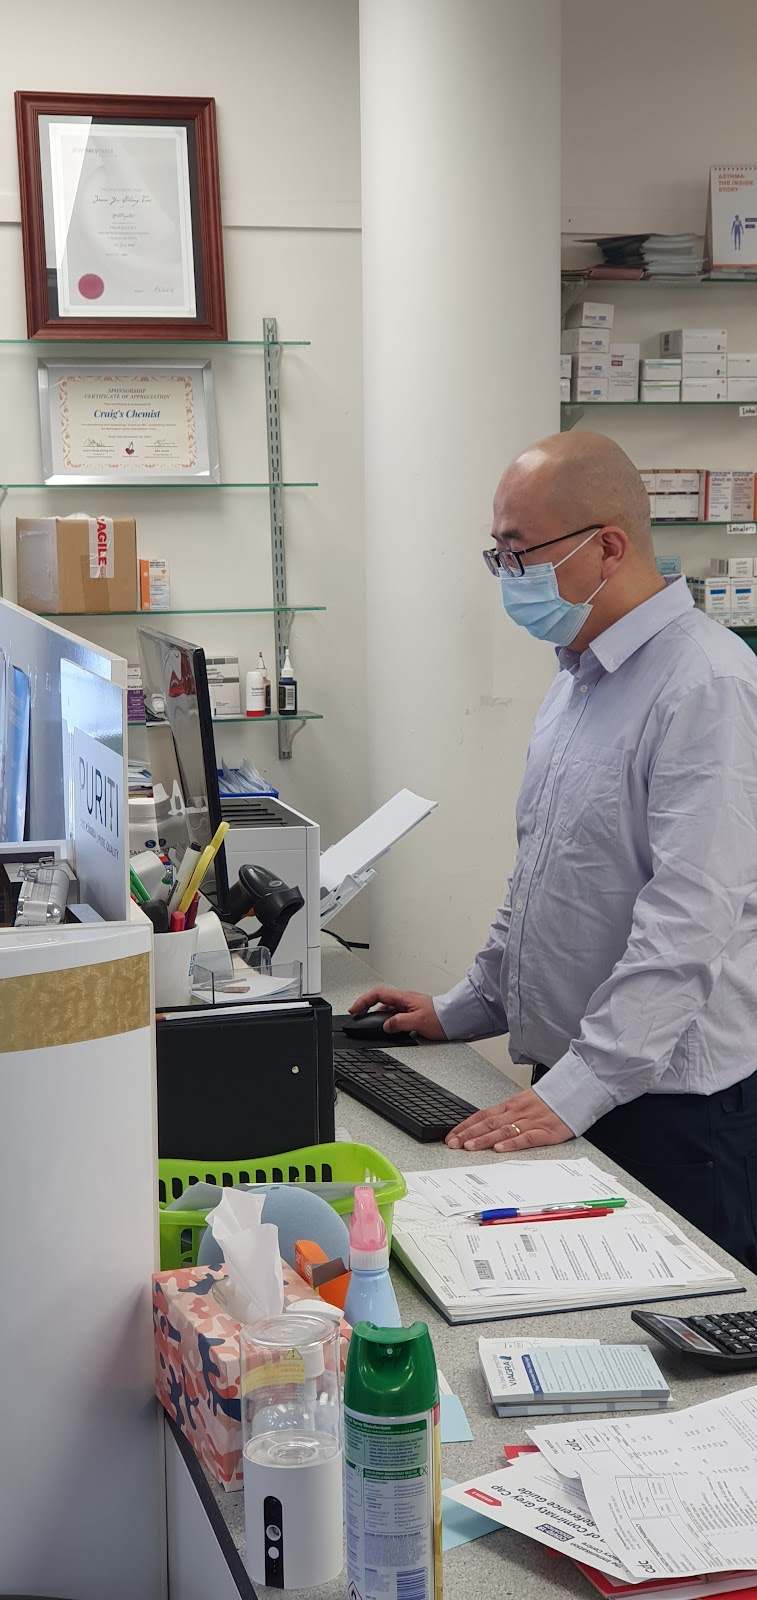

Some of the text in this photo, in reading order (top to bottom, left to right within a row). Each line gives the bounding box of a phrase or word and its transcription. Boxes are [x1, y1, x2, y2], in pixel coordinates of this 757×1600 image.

[93, 408, 161, 420] Craig's Chemist
[96, 518, 108, 566] AGILE
[79, 756, 119, 839] PURITI
[503, 1361, 517, 1386] VIAGRA
[491, 1485, 512, 1497] Cap
[512, 1495, 536, 1508] Grey
[518, 1487, 548, 1503] Guide
[538, 1506, 588, 1534] Comirnaty
[546, 1501, 597, 1528] Reference
